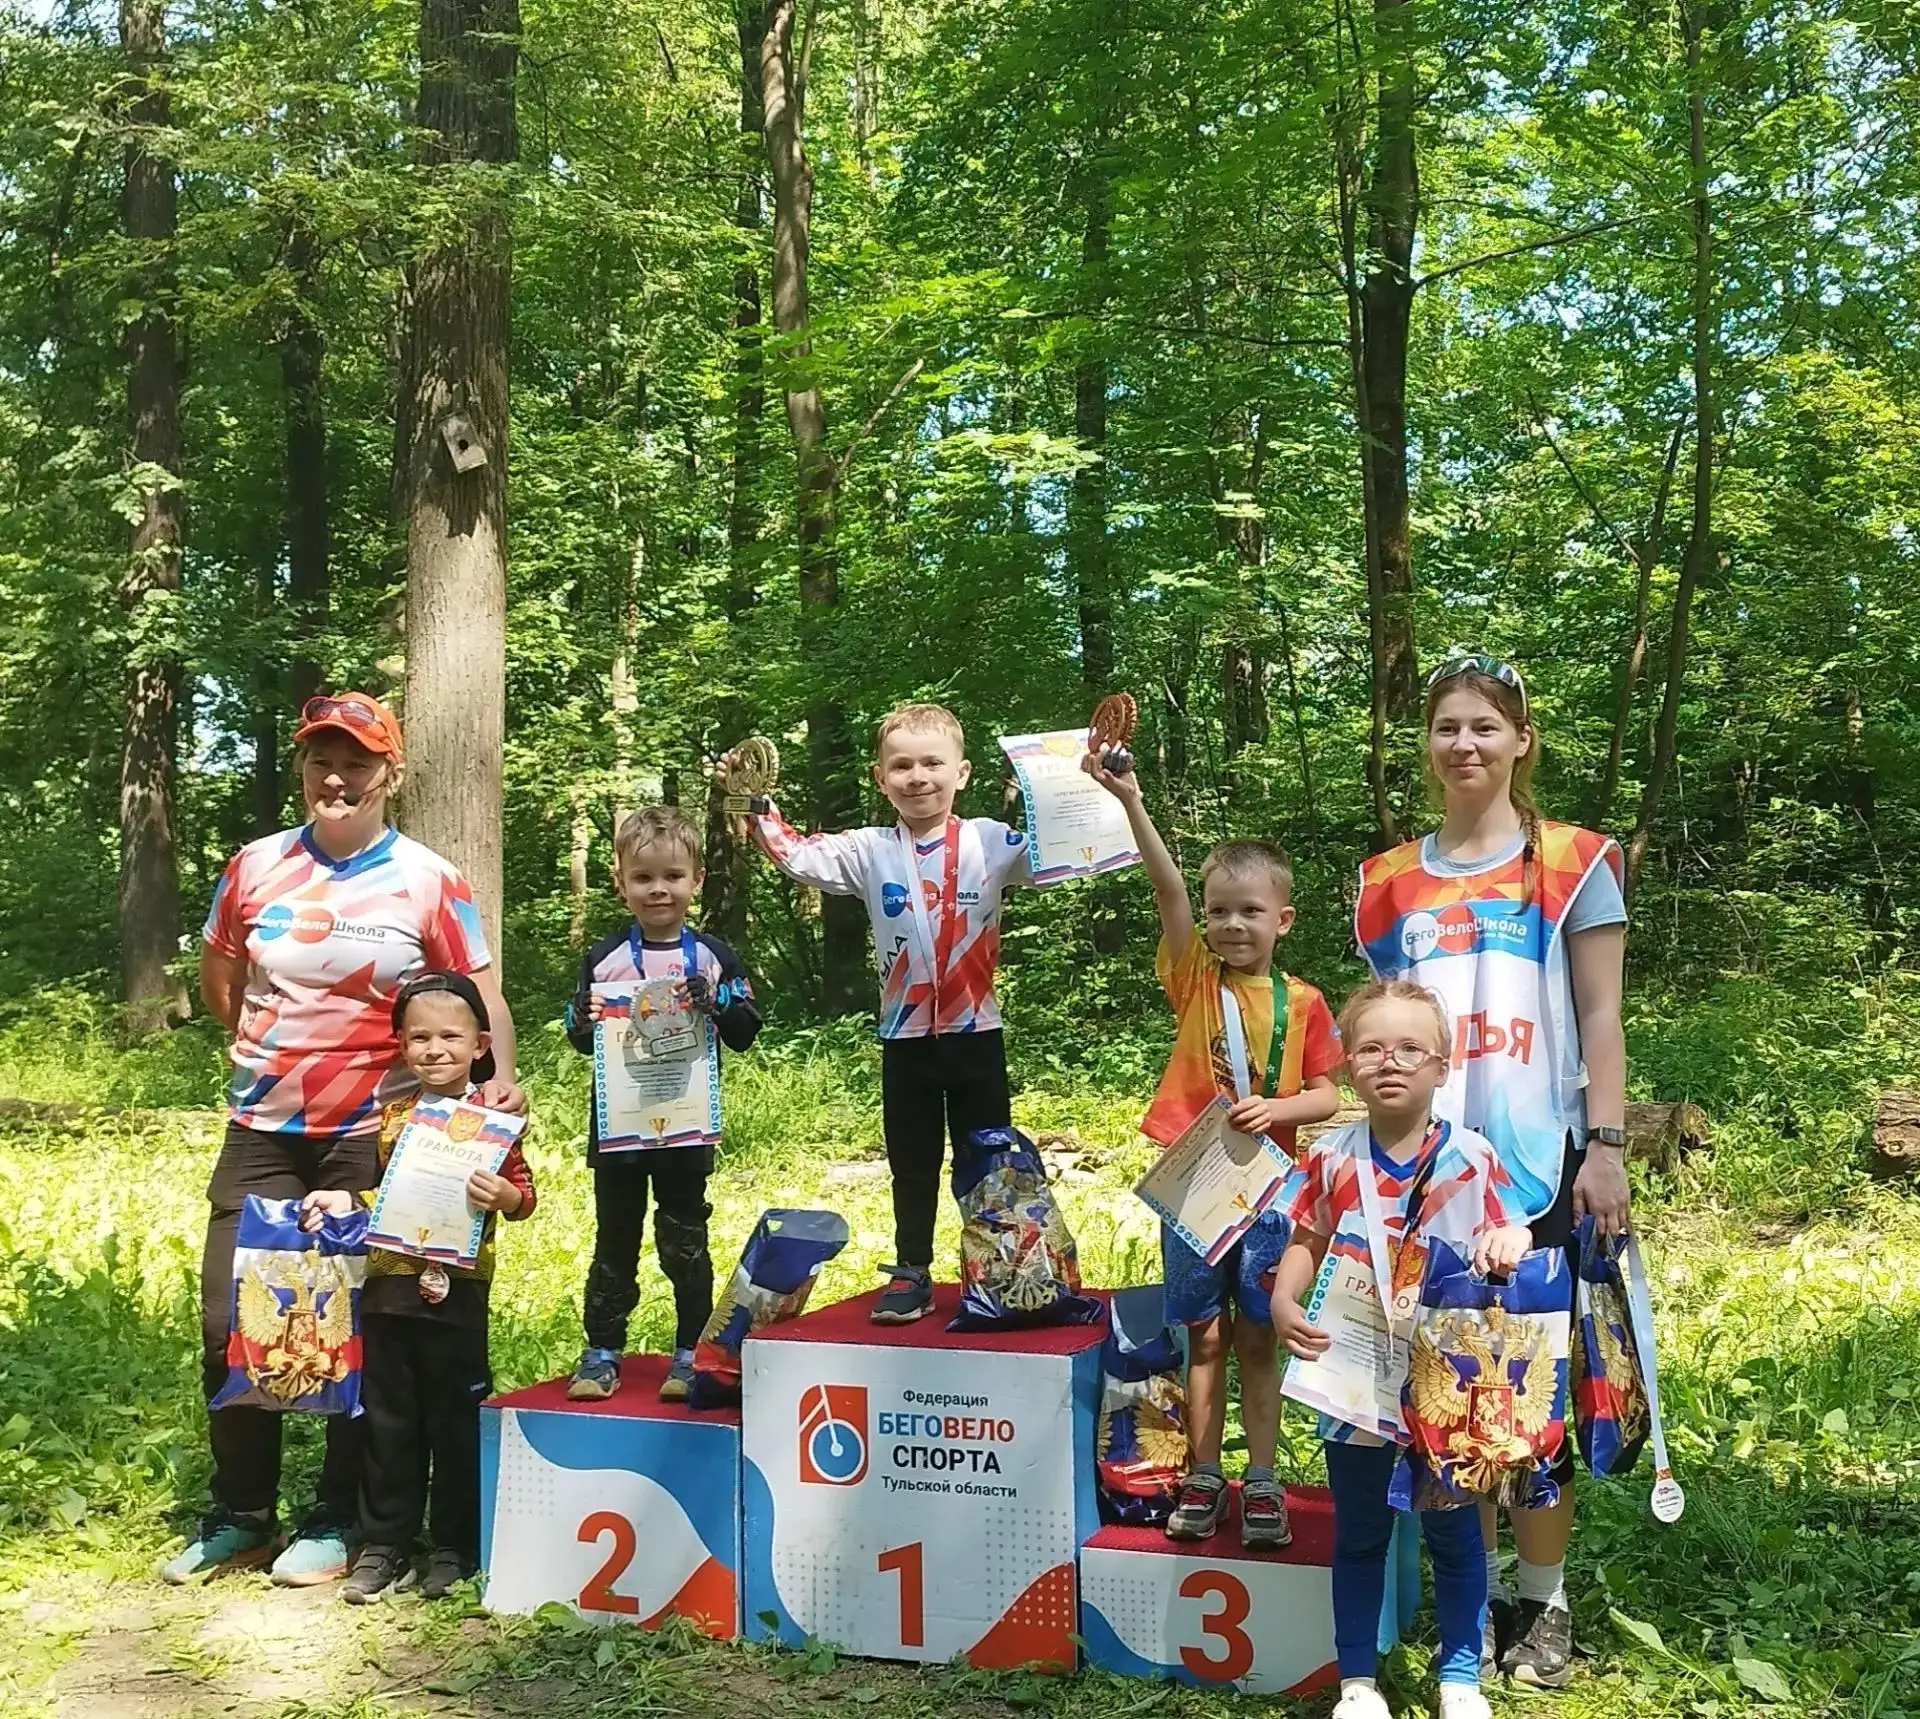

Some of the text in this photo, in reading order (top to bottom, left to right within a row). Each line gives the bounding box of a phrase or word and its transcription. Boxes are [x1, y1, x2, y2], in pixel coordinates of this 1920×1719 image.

[1452, 1009, 1535, 1070] ДЬЯ
[417, 1137, 483, 1162] ГРАМОТА
[903, 1389, 988, 1408] Федерация
[878, 1412, 1015, 1443] БЕГОВЕЛО
[892, 1445, 1001, 1475] СПОРТА
[881, 1476, 1017, 1498] Тульской области
[577, 1511, 639, 1615] 2
[878, 1541, 924, 1647] 1
[1178, 1569, 1254, 1681] 3
